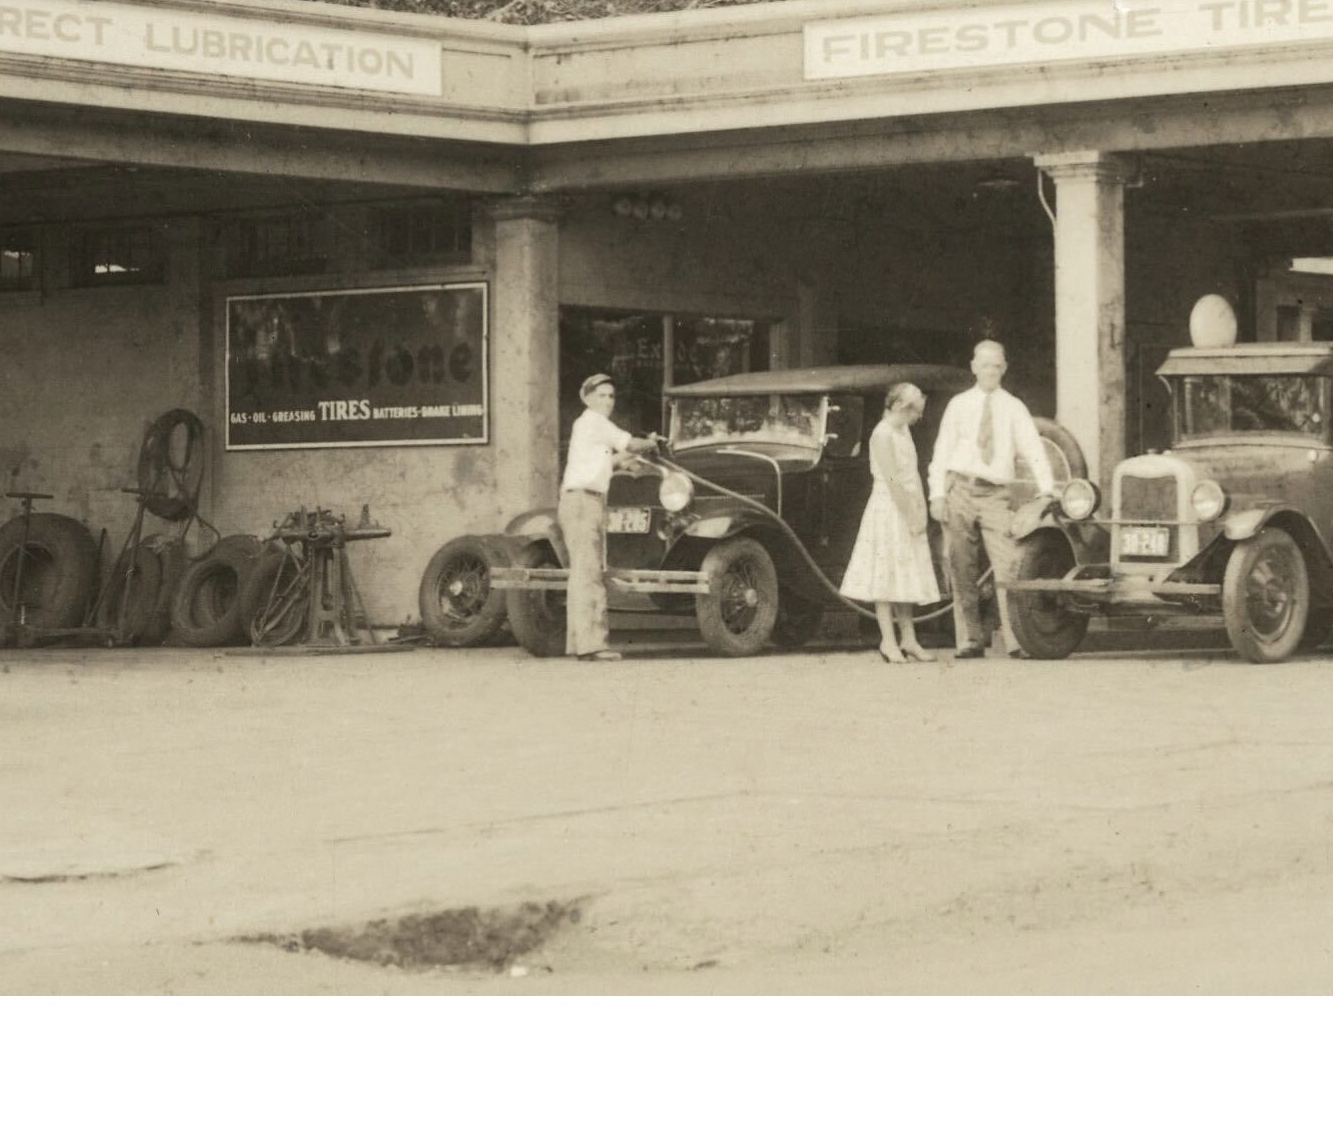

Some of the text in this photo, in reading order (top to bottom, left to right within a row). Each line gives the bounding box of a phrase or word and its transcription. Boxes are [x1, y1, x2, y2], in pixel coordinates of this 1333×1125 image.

[143, 22, 415, 79] LUBRICATION
[822, 7, 1164, 64] FIRESTONE
[233, 334, 474, 396] stone
[637, 338, 699, 363] Exde
[318, 399, 371, 421] TIRES
